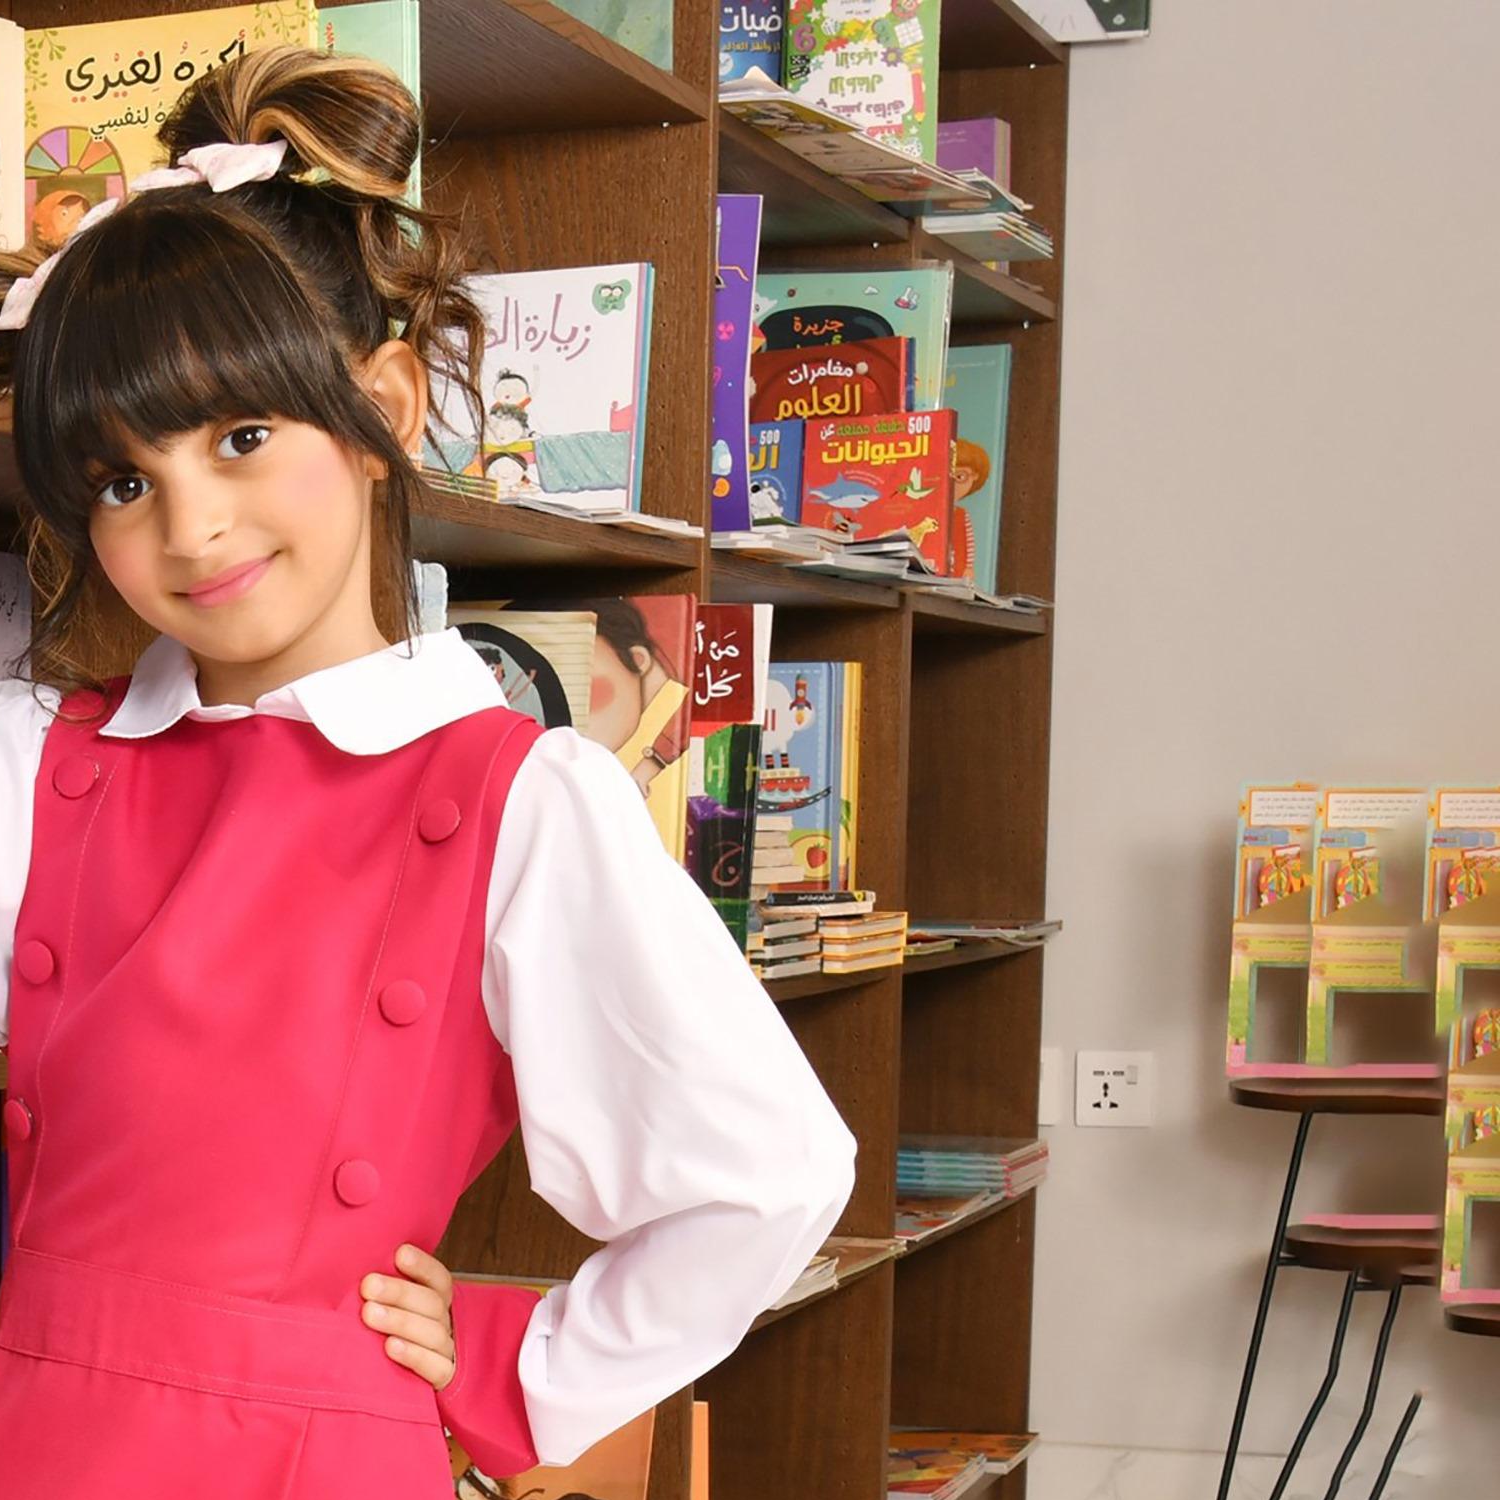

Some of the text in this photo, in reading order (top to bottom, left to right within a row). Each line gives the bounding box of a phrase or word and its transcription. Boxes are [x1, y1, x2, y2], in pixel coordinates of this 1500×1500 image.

[525, 294, 591, 361] زيارة
[793, 317, 844, 336] جزيرة
[788, 358, 854, 385] مغامرات
[775, 384, 861, 421] العلوم
[820, 423, 835, 440] عن
[908, 415, 931, 434] 500
[759, 429, 781, 445] 500
[821, 434, 929, 466] الحيوانات
